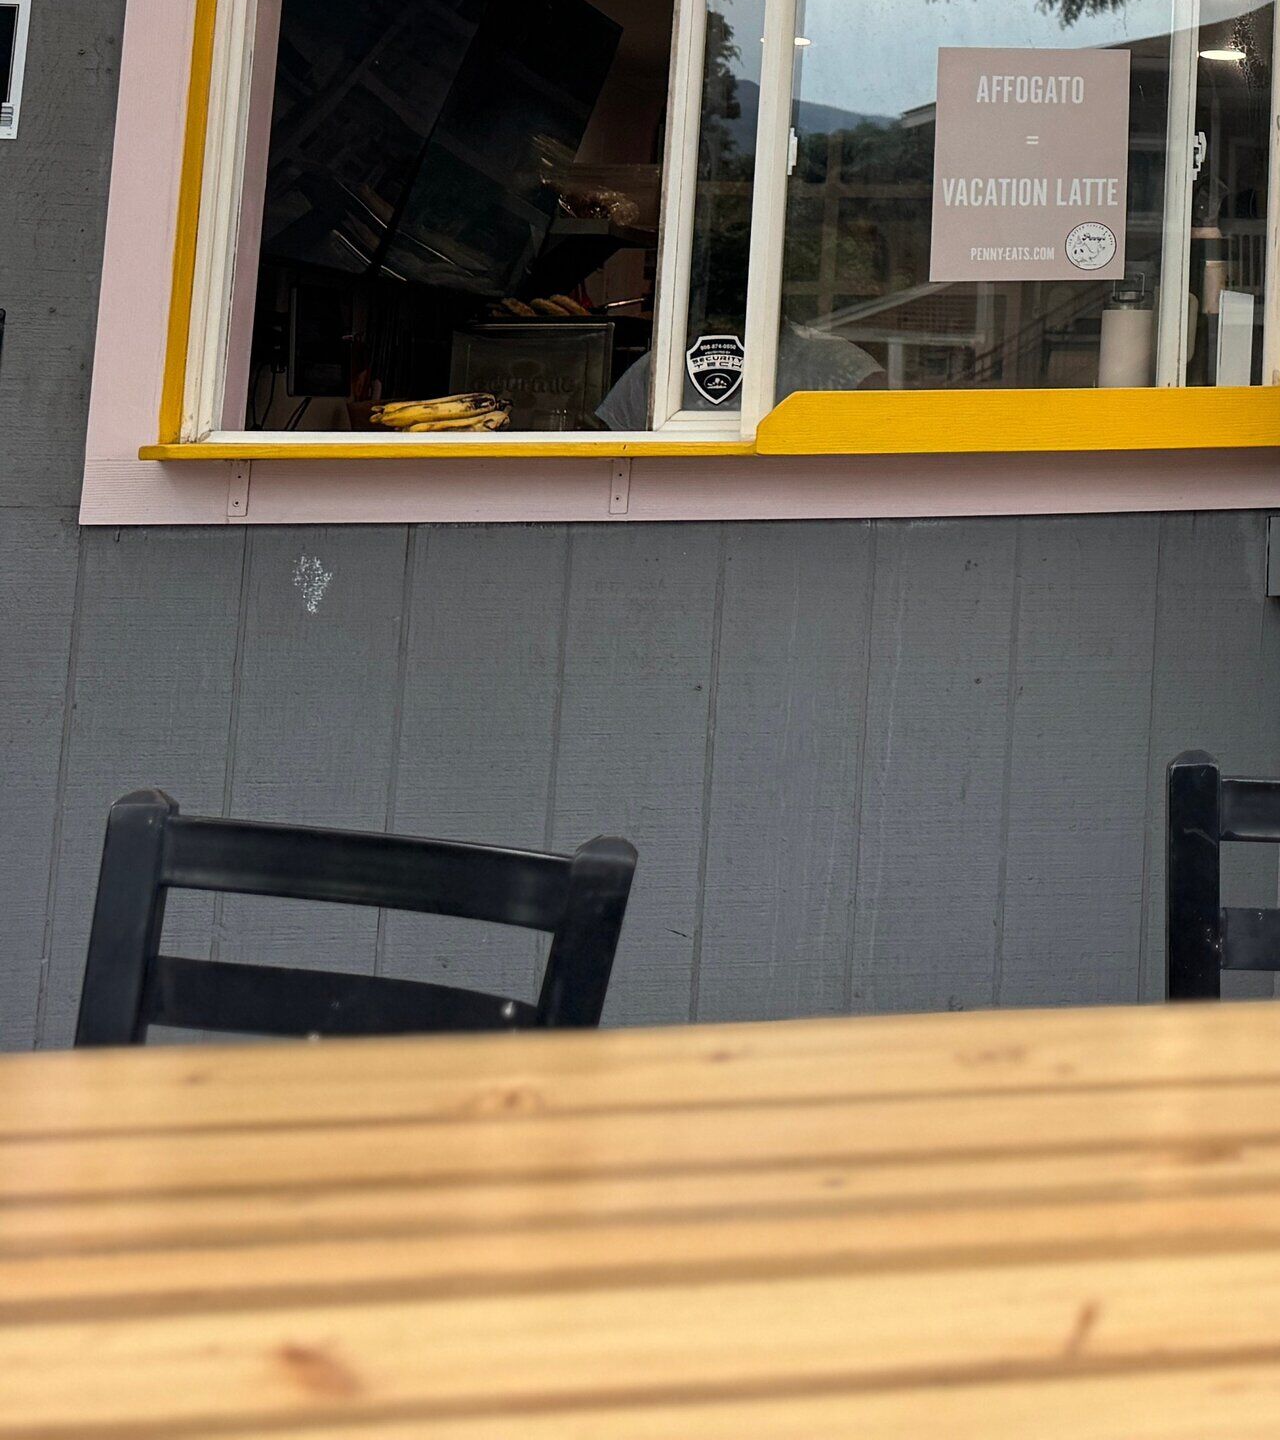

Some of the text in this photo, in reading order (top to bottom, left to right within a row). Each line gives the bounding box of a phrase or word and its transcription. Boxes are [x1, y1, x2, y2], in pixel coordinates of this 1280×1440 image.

[976, 75, 1084, 104] AFFOGATO
[942, 177, 1119, 207] VACATION LATTE
[970, 247, 1055, 261] PENNY-EATS.COM
[692, 355, 744, 364] SECURITY
